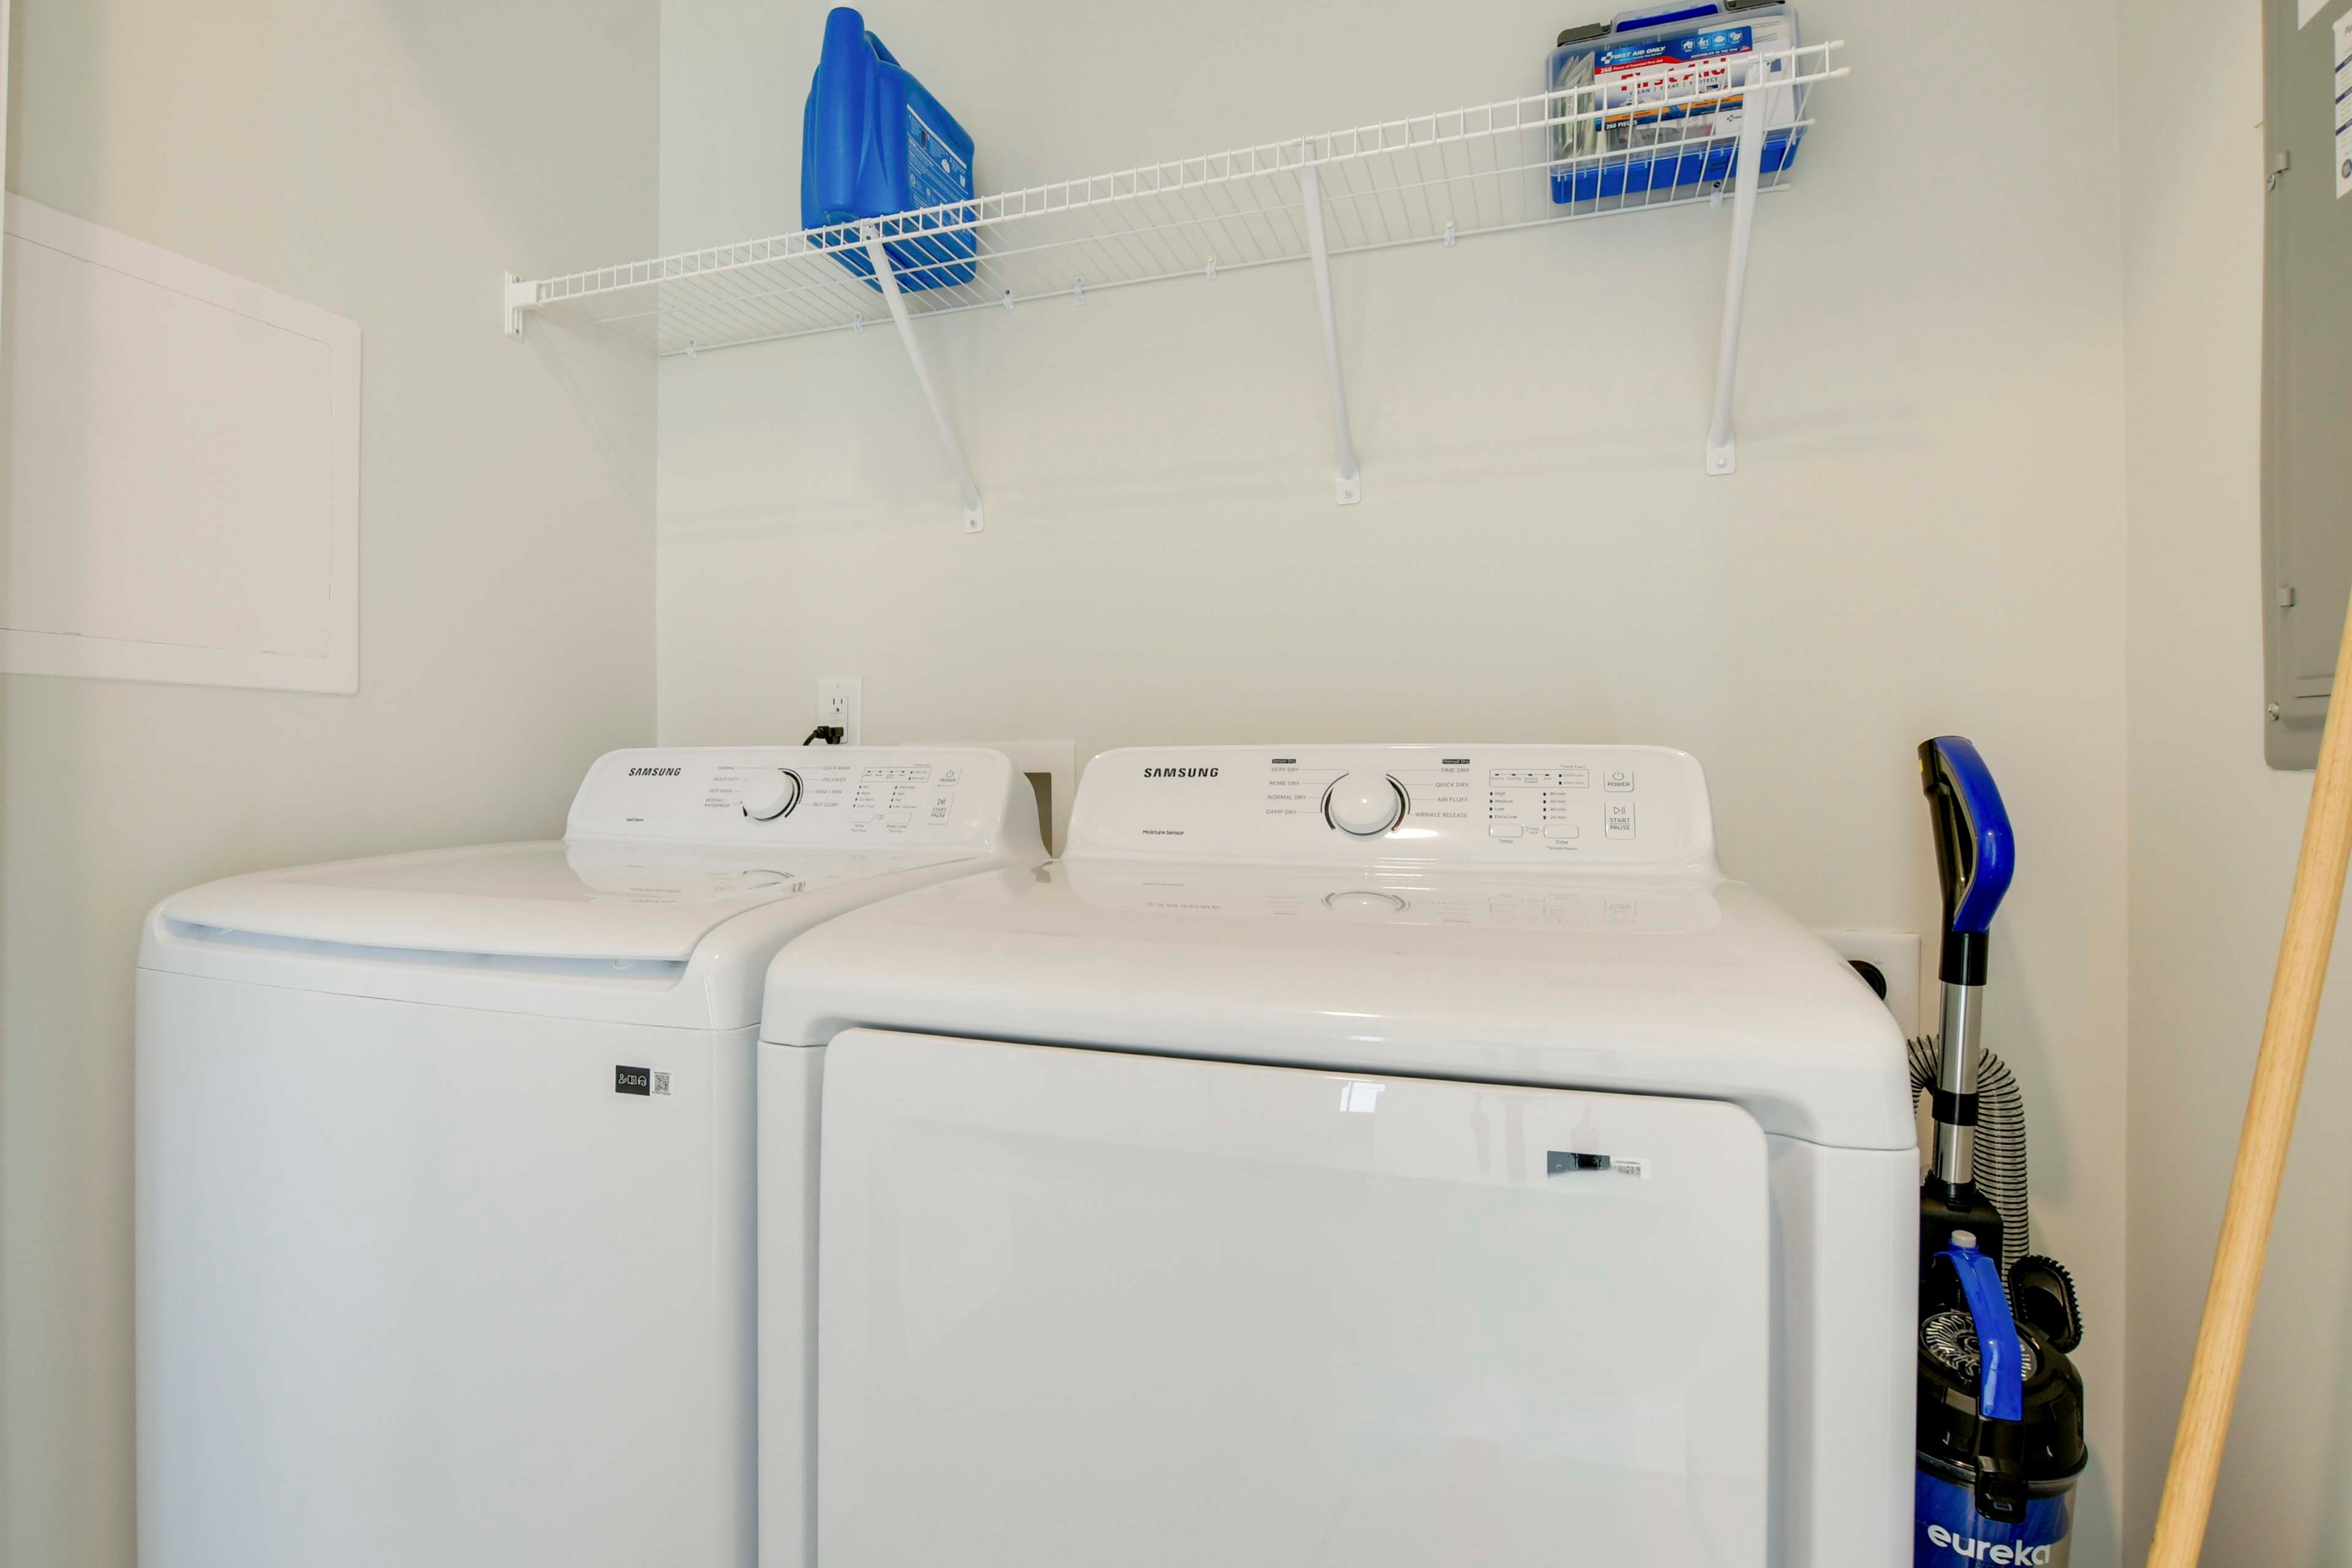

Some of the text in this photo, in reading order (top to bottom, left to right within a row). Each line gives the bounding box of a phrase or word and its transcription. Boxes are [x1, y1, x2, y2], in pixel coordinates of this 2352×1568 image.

[1610, 52, 1632, 61] FIRST
[1646, 45, 1666, 54] ONLY
[1629, 77, 1718, 96] CEAN TEAT POTECT
[628, 767, 682, 776] SAMSUNG
[1144, 767, 1219, 778] SAMSUNG
[1927, 1524, 2051, 1566] eureka
